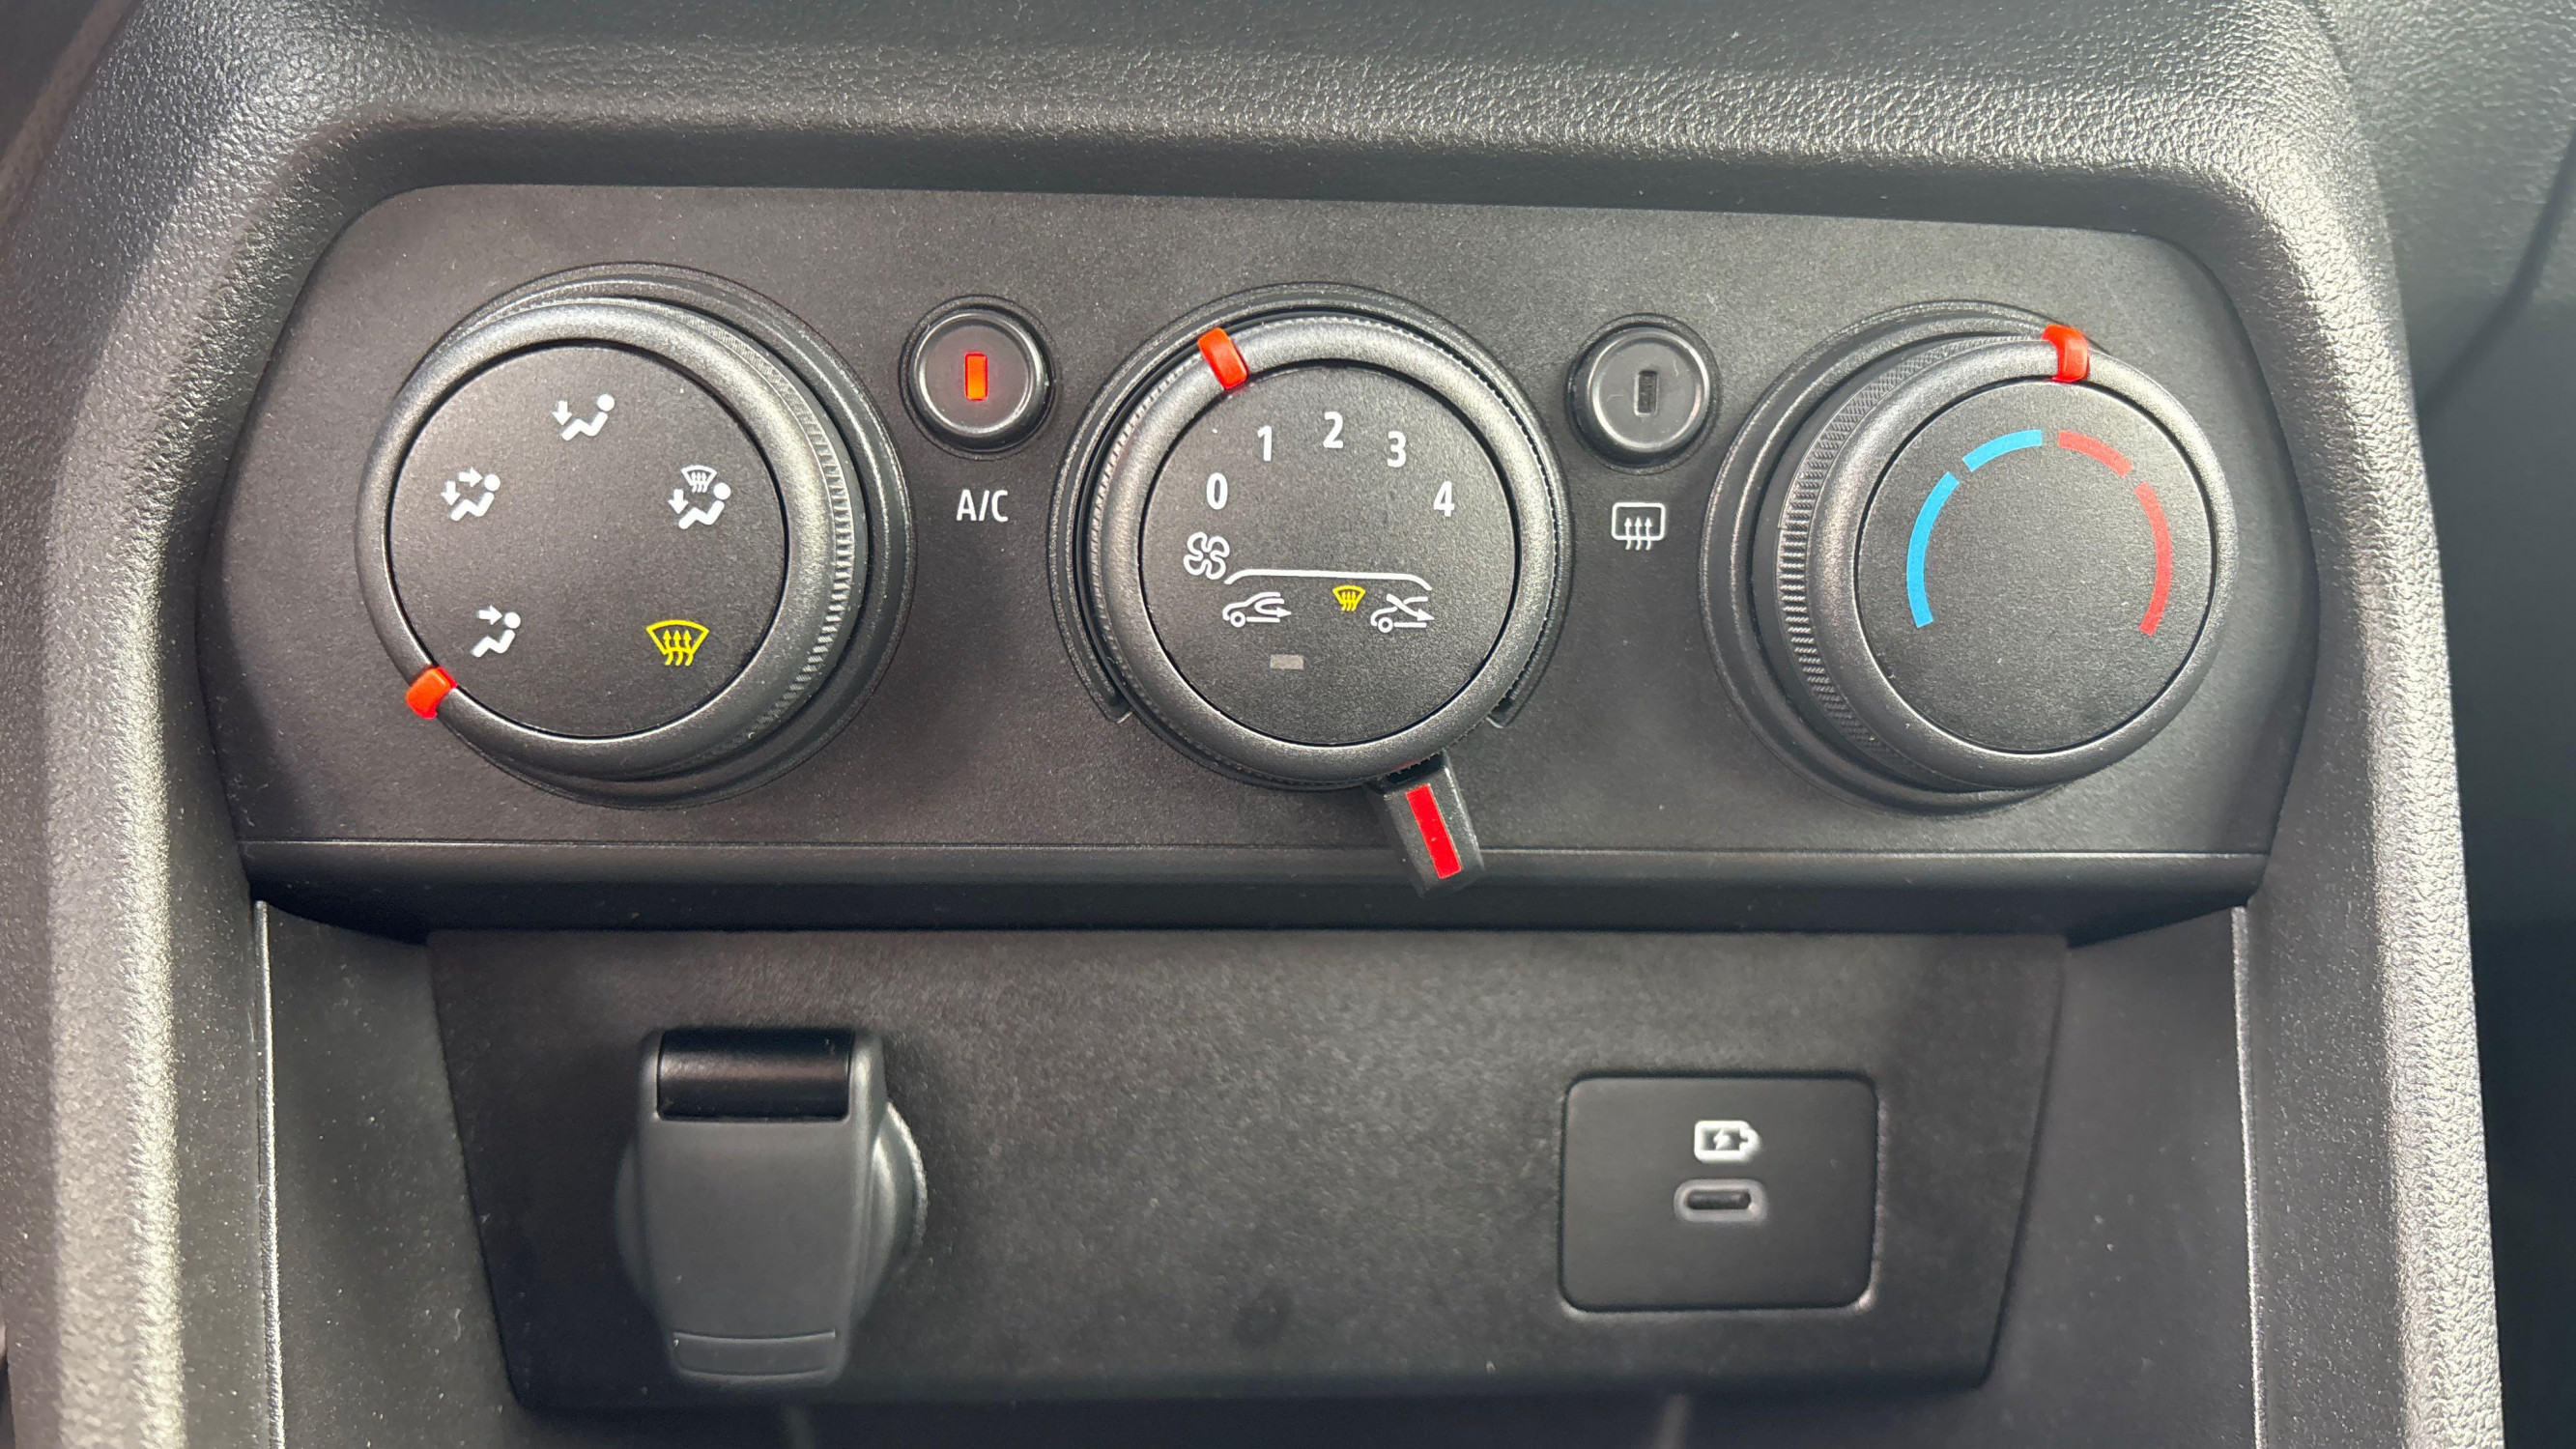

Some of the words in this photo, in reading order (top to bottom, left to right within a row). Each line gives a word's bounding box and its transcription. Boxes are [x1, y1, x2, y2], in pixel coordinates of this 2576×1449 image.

[1257, 426, 1273, 462] 1
[1323, 412, 1344, 449] 2
[1388, 431, 1407, 468] 3
[956, 489, 1009, 523] A/C
[1206, 472, 1228, 510] 0
[1433, 481, 1455, 517] 4
